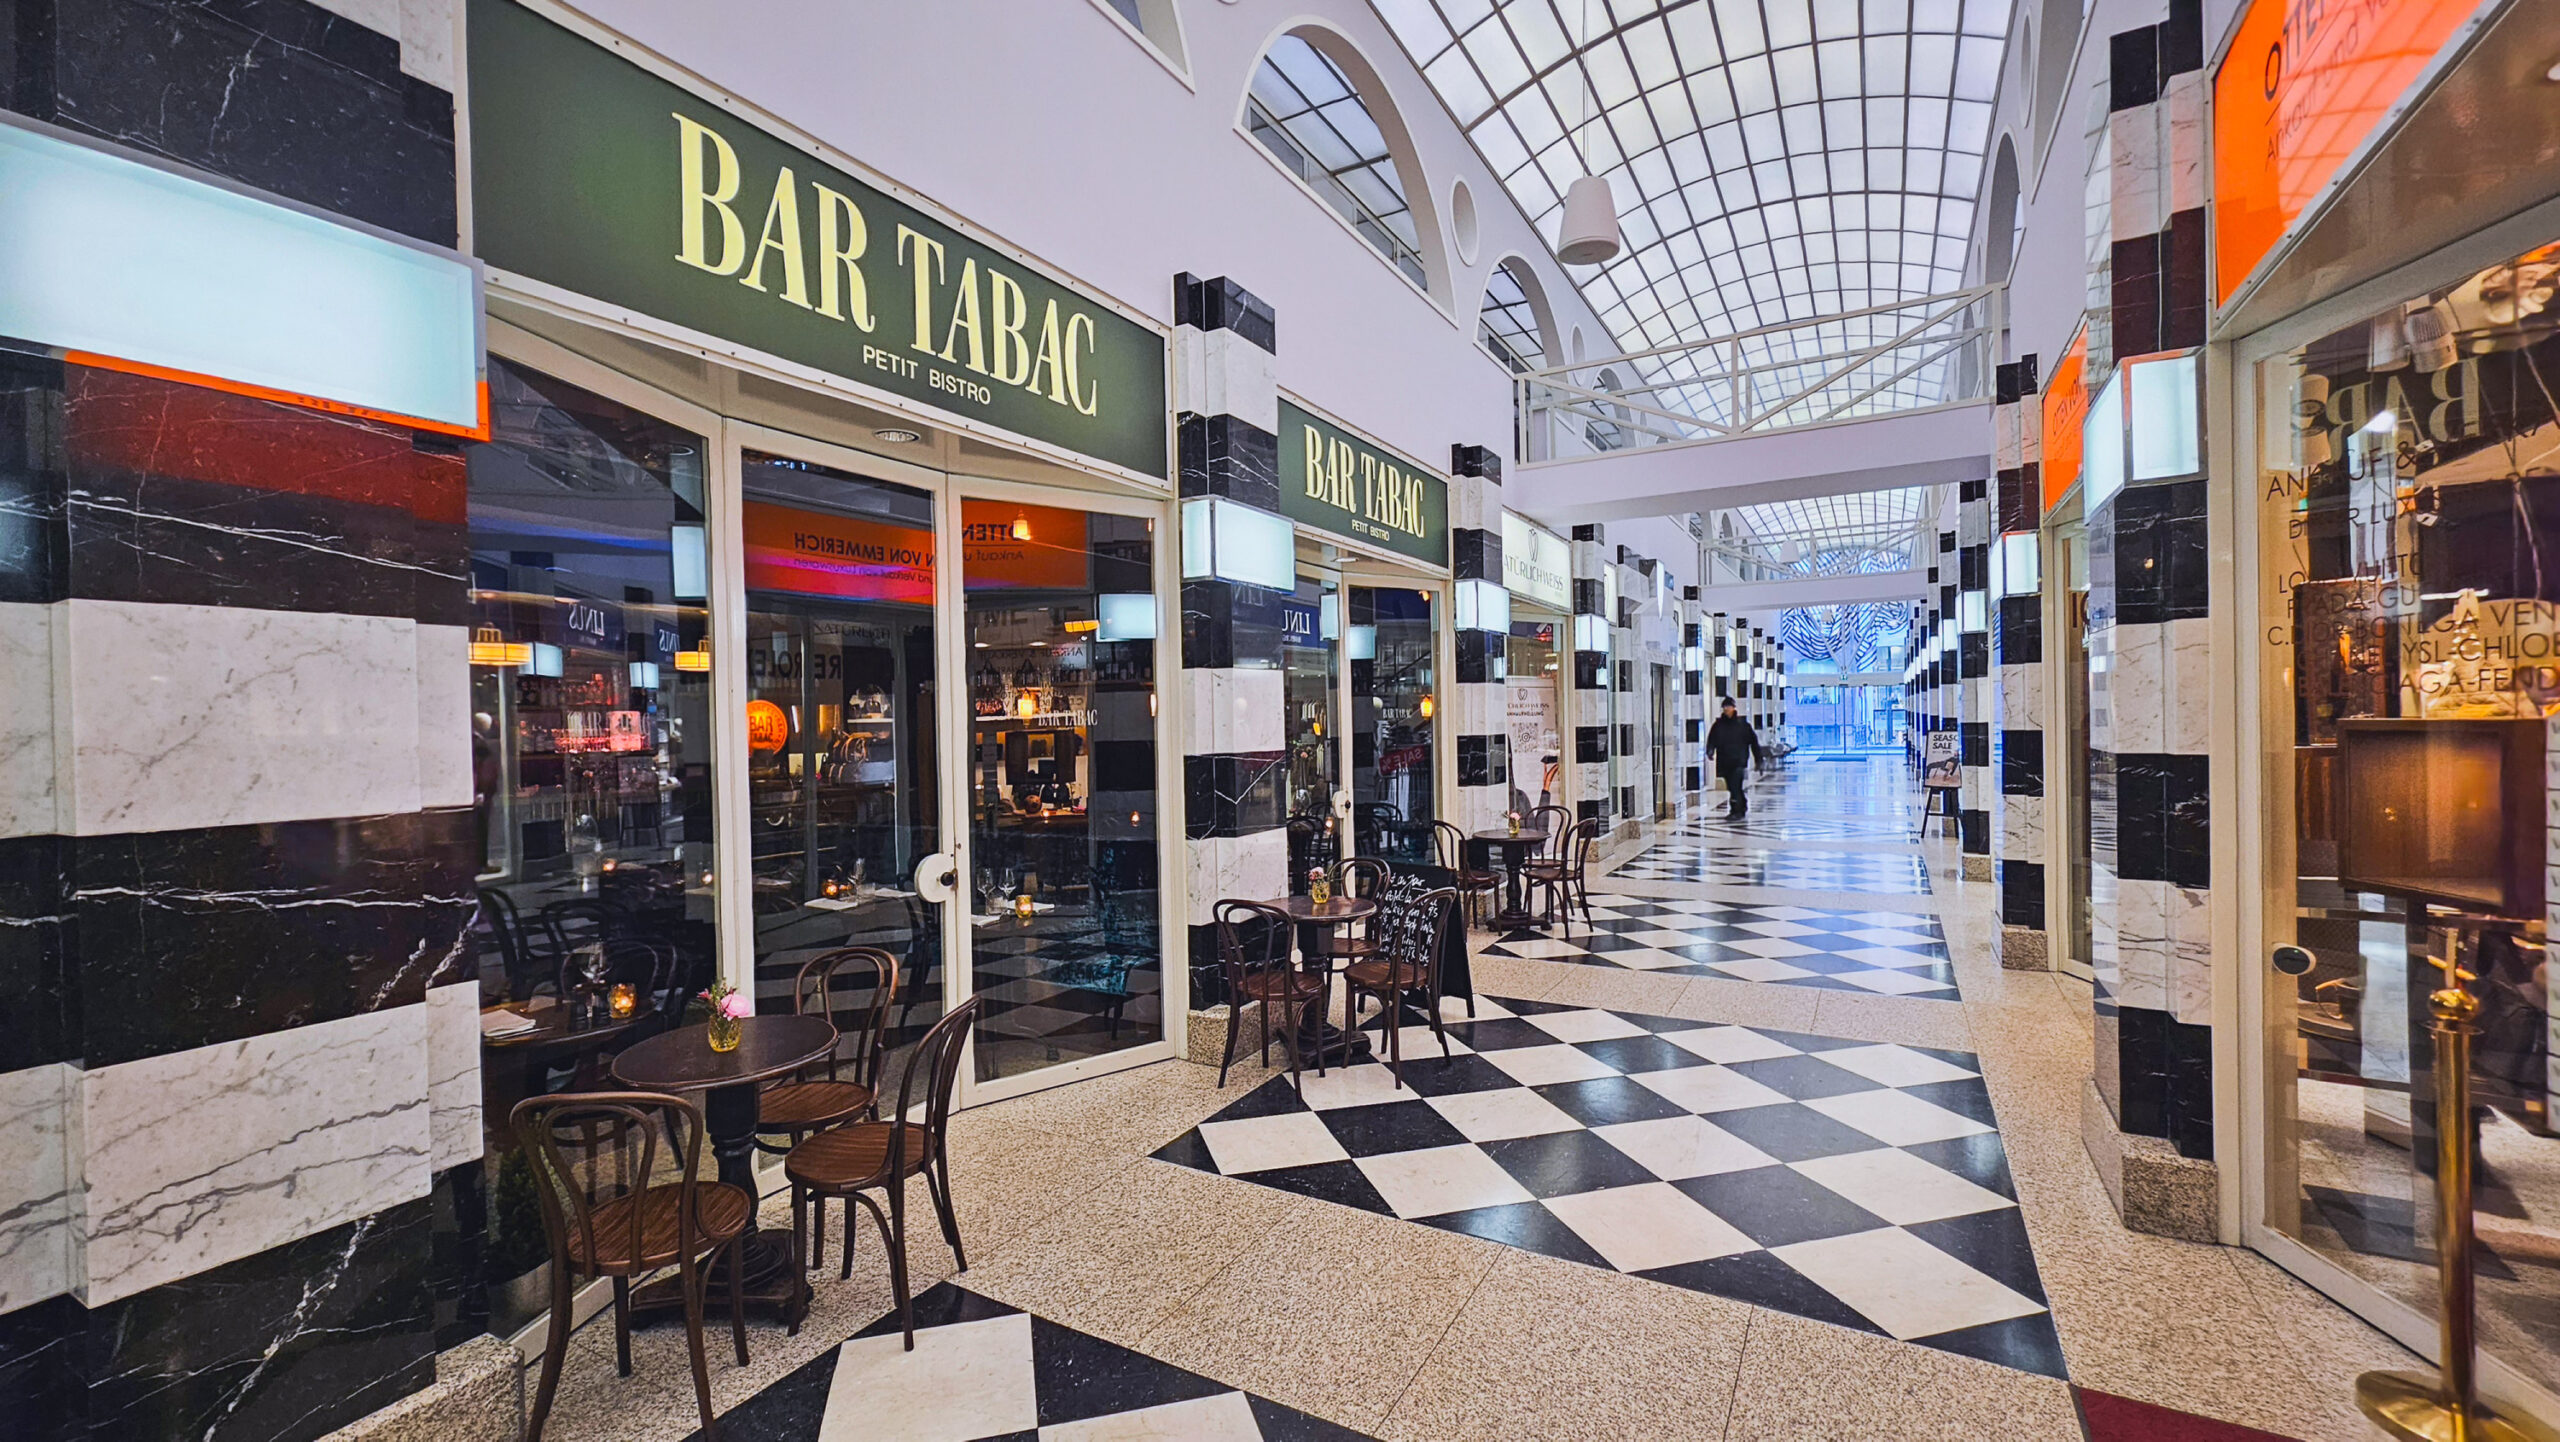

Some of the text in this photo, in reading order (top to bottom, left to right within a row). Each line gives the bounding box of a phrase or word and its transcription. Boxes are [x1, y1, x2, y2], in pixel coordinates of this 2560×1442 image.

[672, 112, 1097, 417] BAR TABAC
[863, 344, 990, 405] PETIT BISTRO
[1303, 423, 1424, 538] BAR TABAC
[1352, 519, 1390, 542] PETIT BISTRO
[749, 715, 773, 732] BAR
[1038, 709, 1098, 727] BAR TABAC
[1932, 741, 1952, 750] SALE
